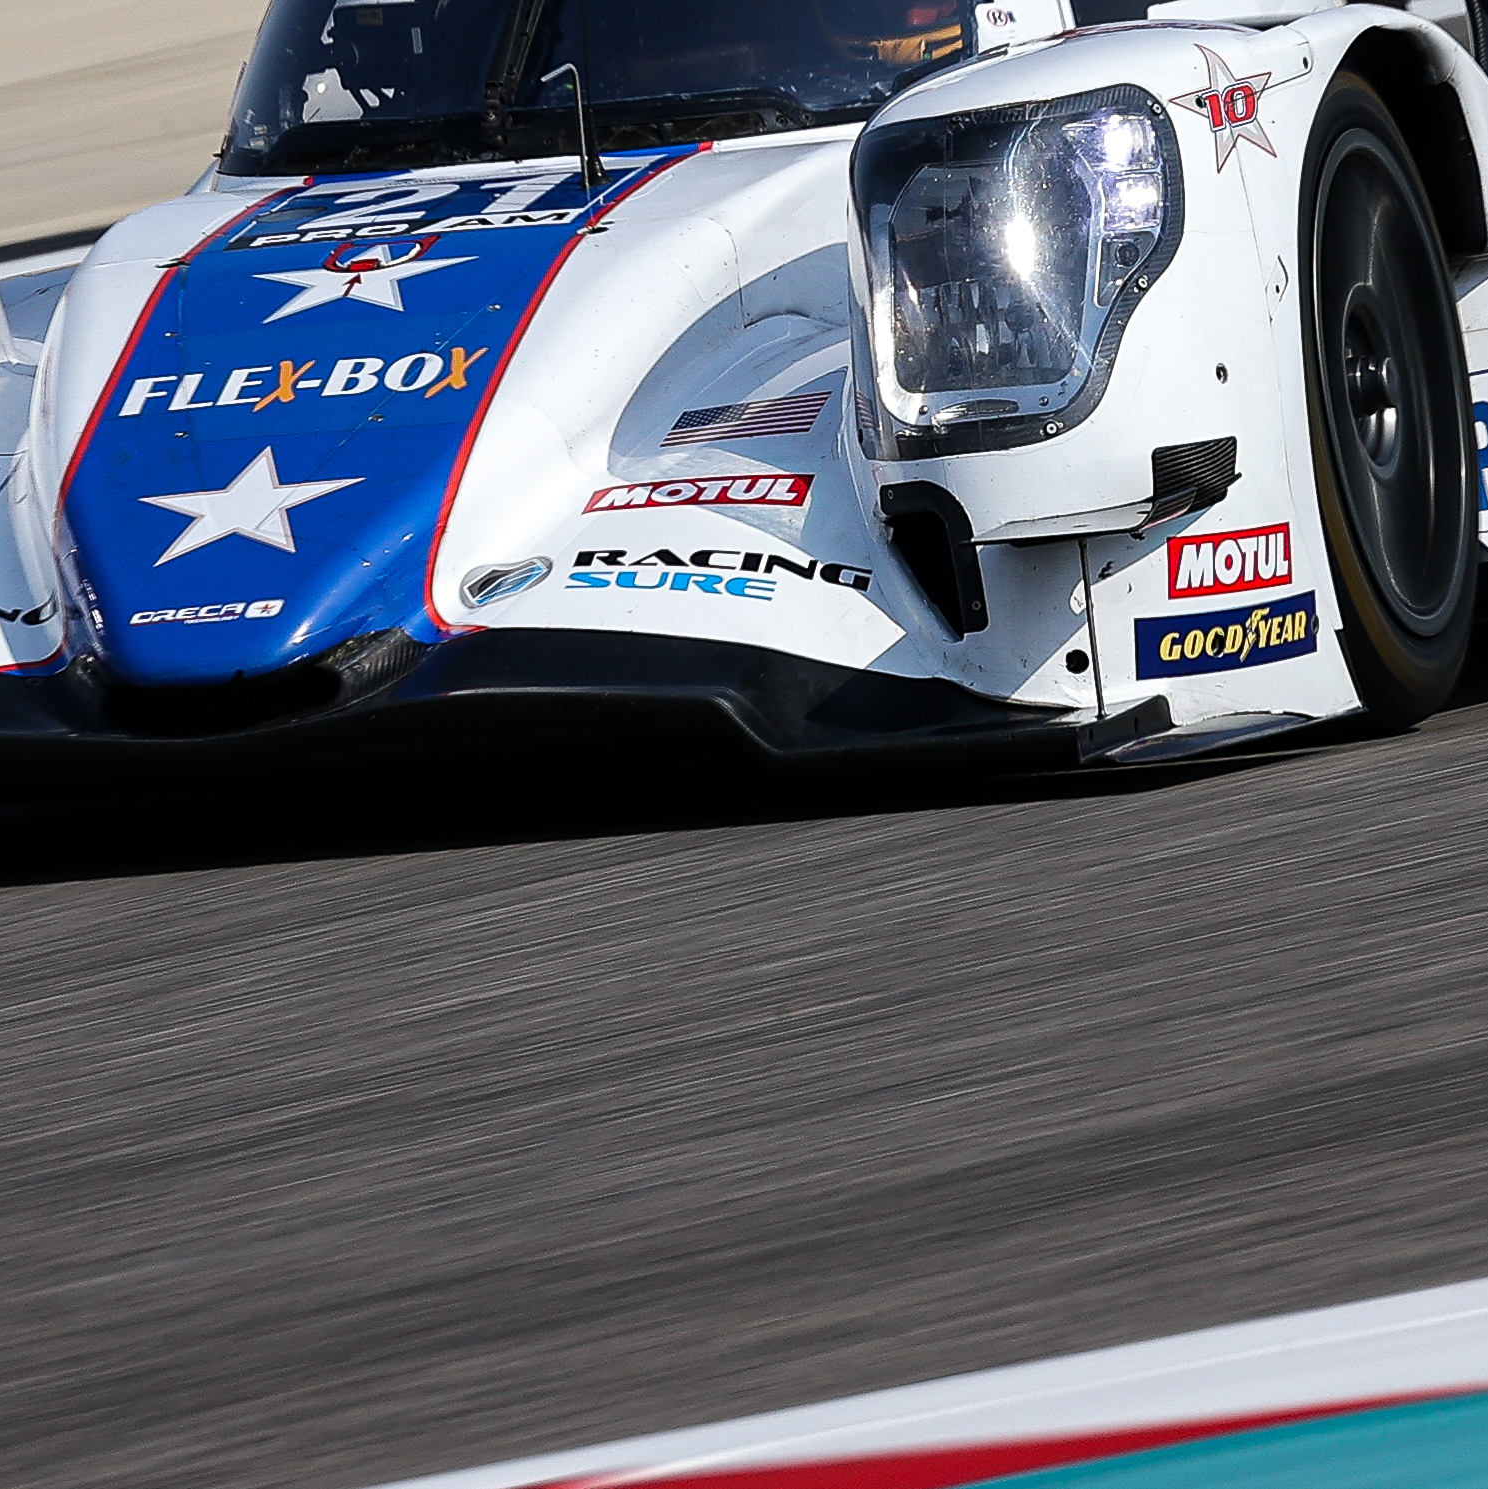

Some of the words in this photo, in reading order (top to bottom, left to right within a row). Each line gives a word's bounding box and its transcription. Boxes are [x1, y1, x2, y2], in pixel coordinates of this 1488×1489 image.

[1201, 81, 1259, 133] 10
[298, 172, 575, 231] 21
[249, 224, 410, 247] PRO
[442, 212, 572, 230] AM
[118, 347, 490, 417] FLEX-BOX
[593, 478, 800, 510] MOTUL
[564, 571, 778, 601] SURE
[573, 548, 873, 592] RACING
[1175, 532, 1289, 590] MOTUL
[1159, 607, 1308, 662] GOODYEAR
